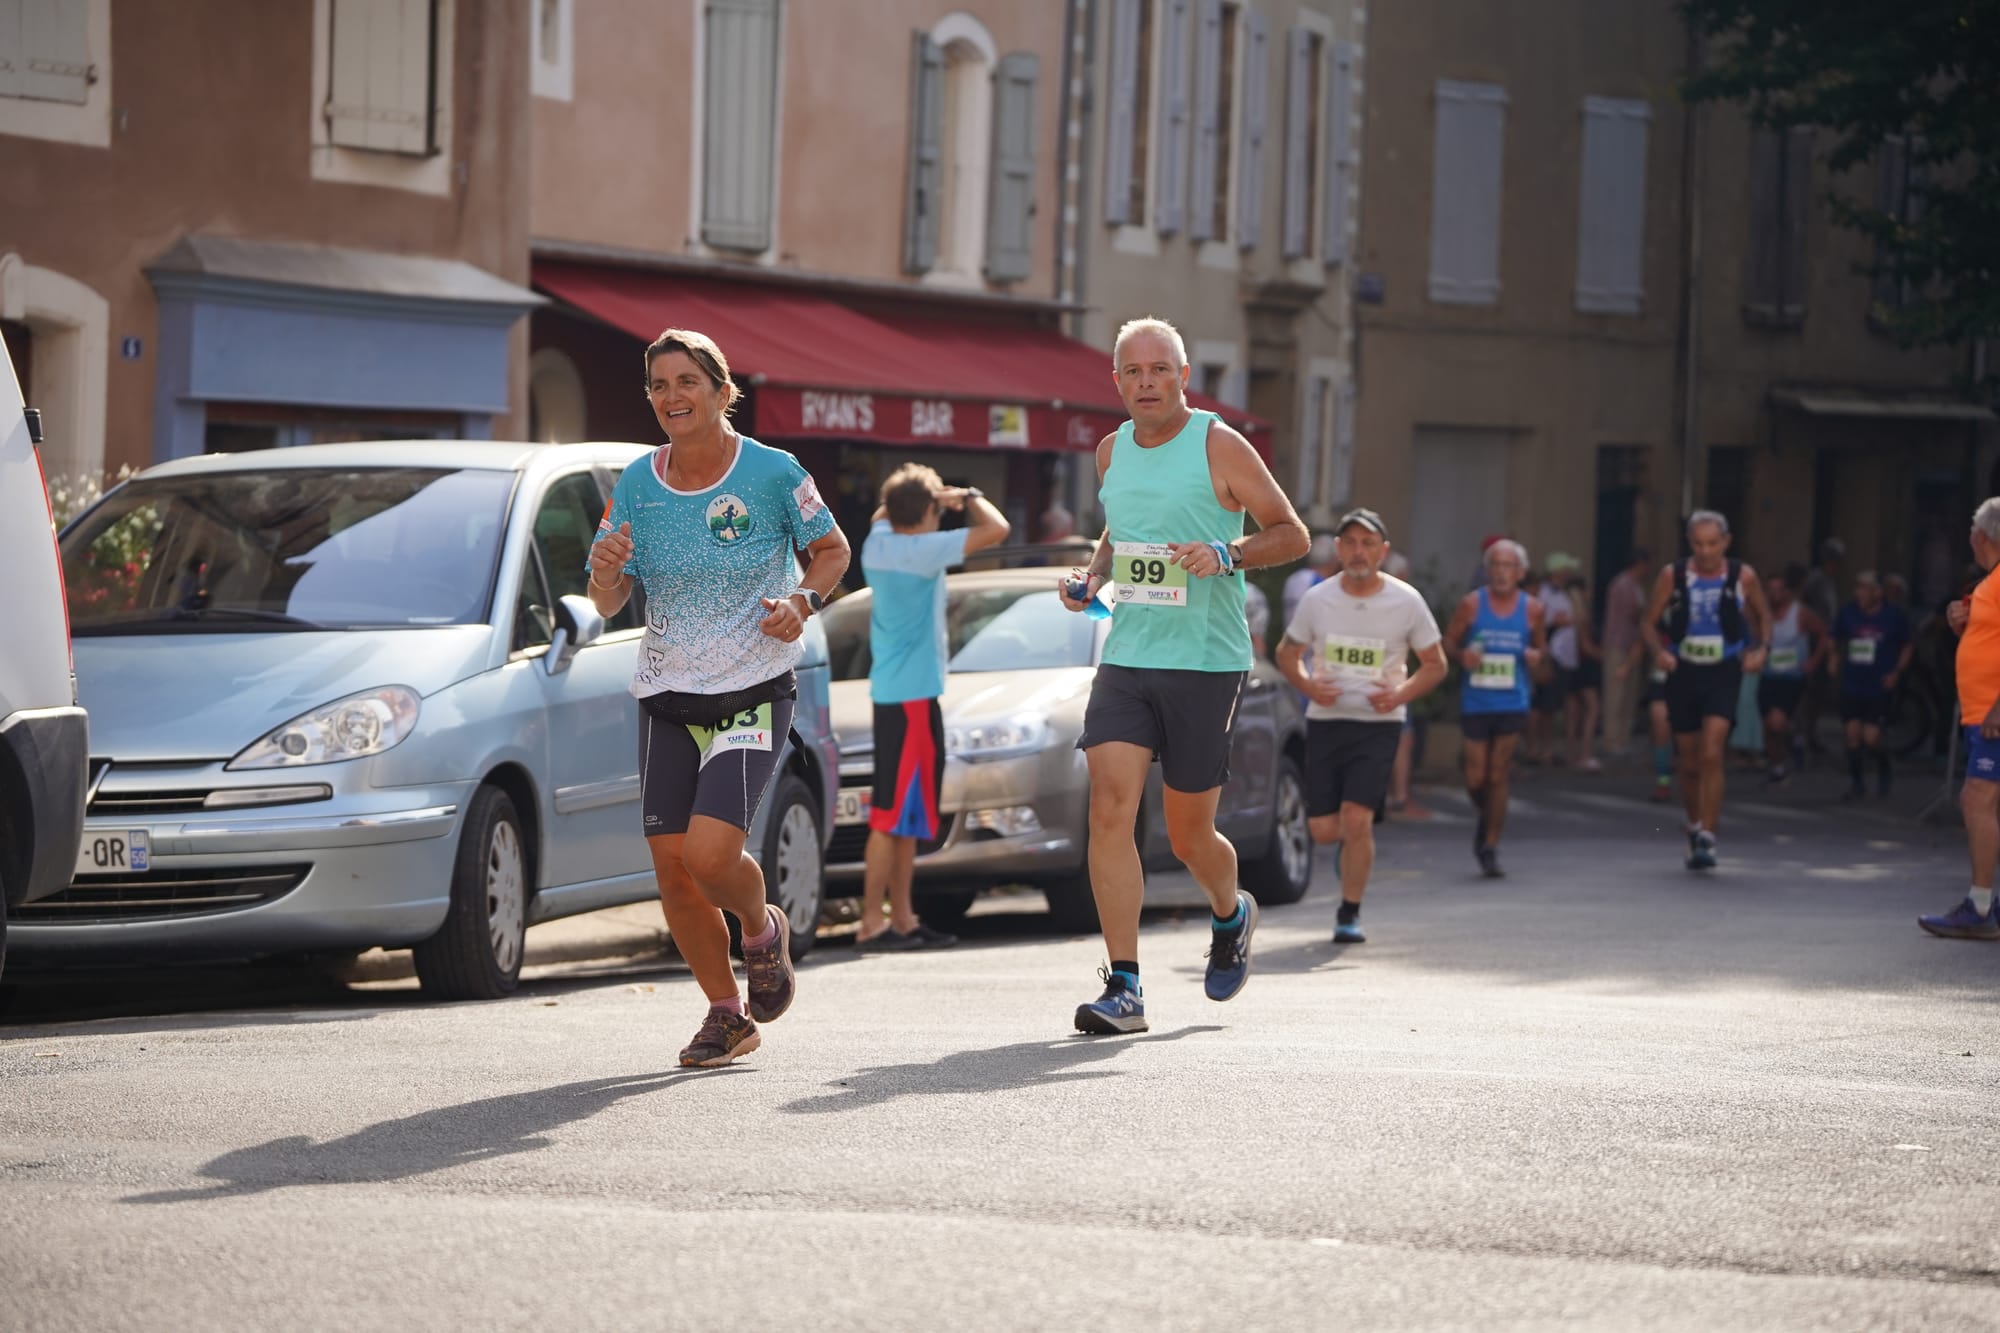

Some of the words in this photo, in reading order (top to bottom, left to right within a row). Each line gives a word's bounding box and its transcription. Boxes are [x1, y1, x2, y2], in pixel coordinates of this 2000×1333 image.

[802, 391, 874, 431] RYAN'S
[911, 400, 954, 436] BAR
[714, 497, 728, 507] TAC
[1131, 559, 1165, 584] 99
[1334, 646, 1374, 666] 188
[727, 734, 755, 743] TUFF'S
[131, 850, 146, 864] 59
